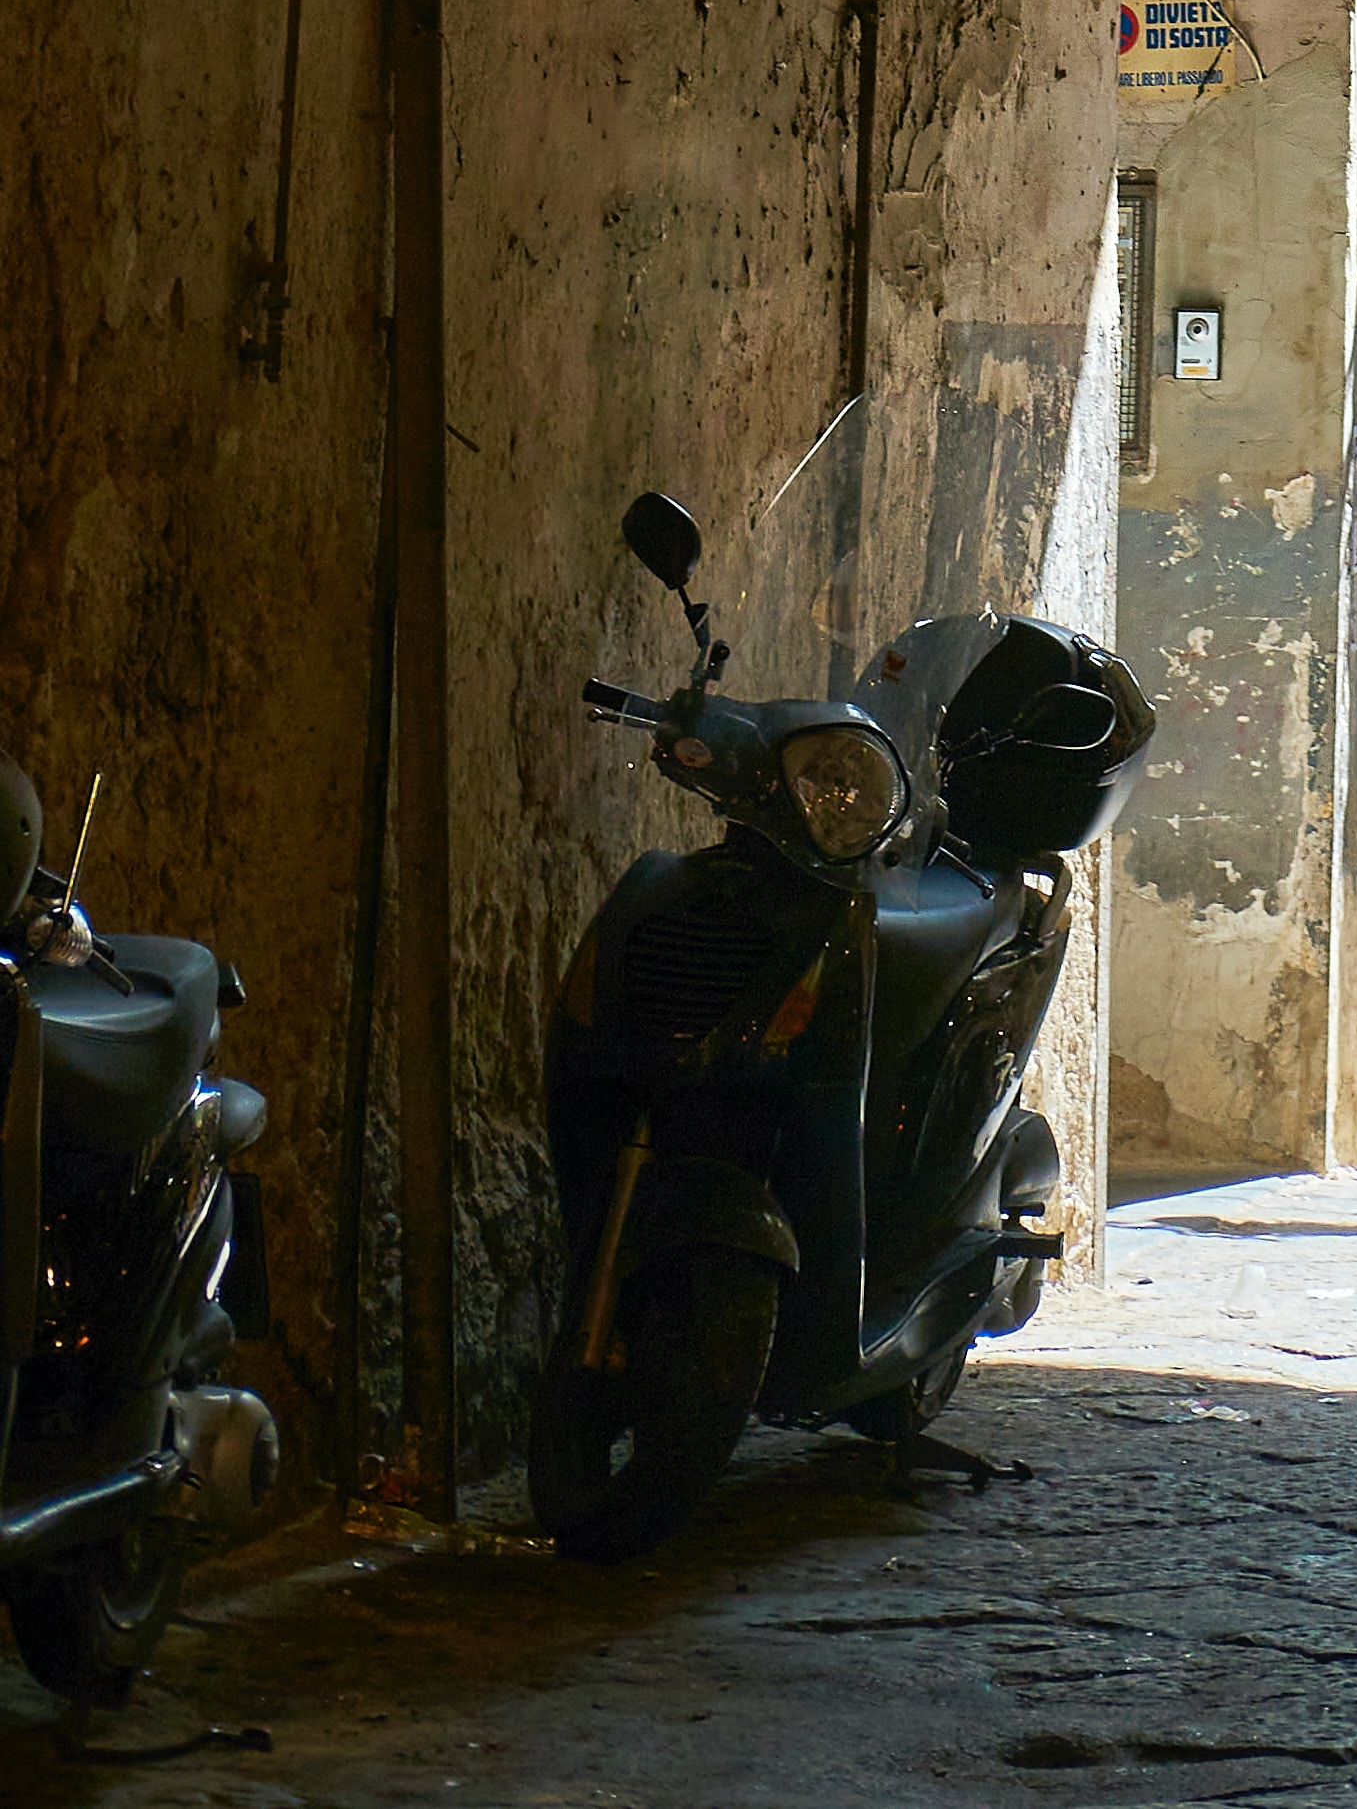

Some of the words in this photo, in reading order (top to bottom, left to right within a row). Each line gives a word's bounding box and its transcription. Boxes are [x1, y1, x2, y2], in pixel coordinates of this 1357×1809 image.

[1145, 1, 1226, 25] DIVIETO
[1146, 28, 1166, 49] DI
[1170, 25, 1231, 49] SOSTA
[1136, 71, 1166, 87] LIBERO
